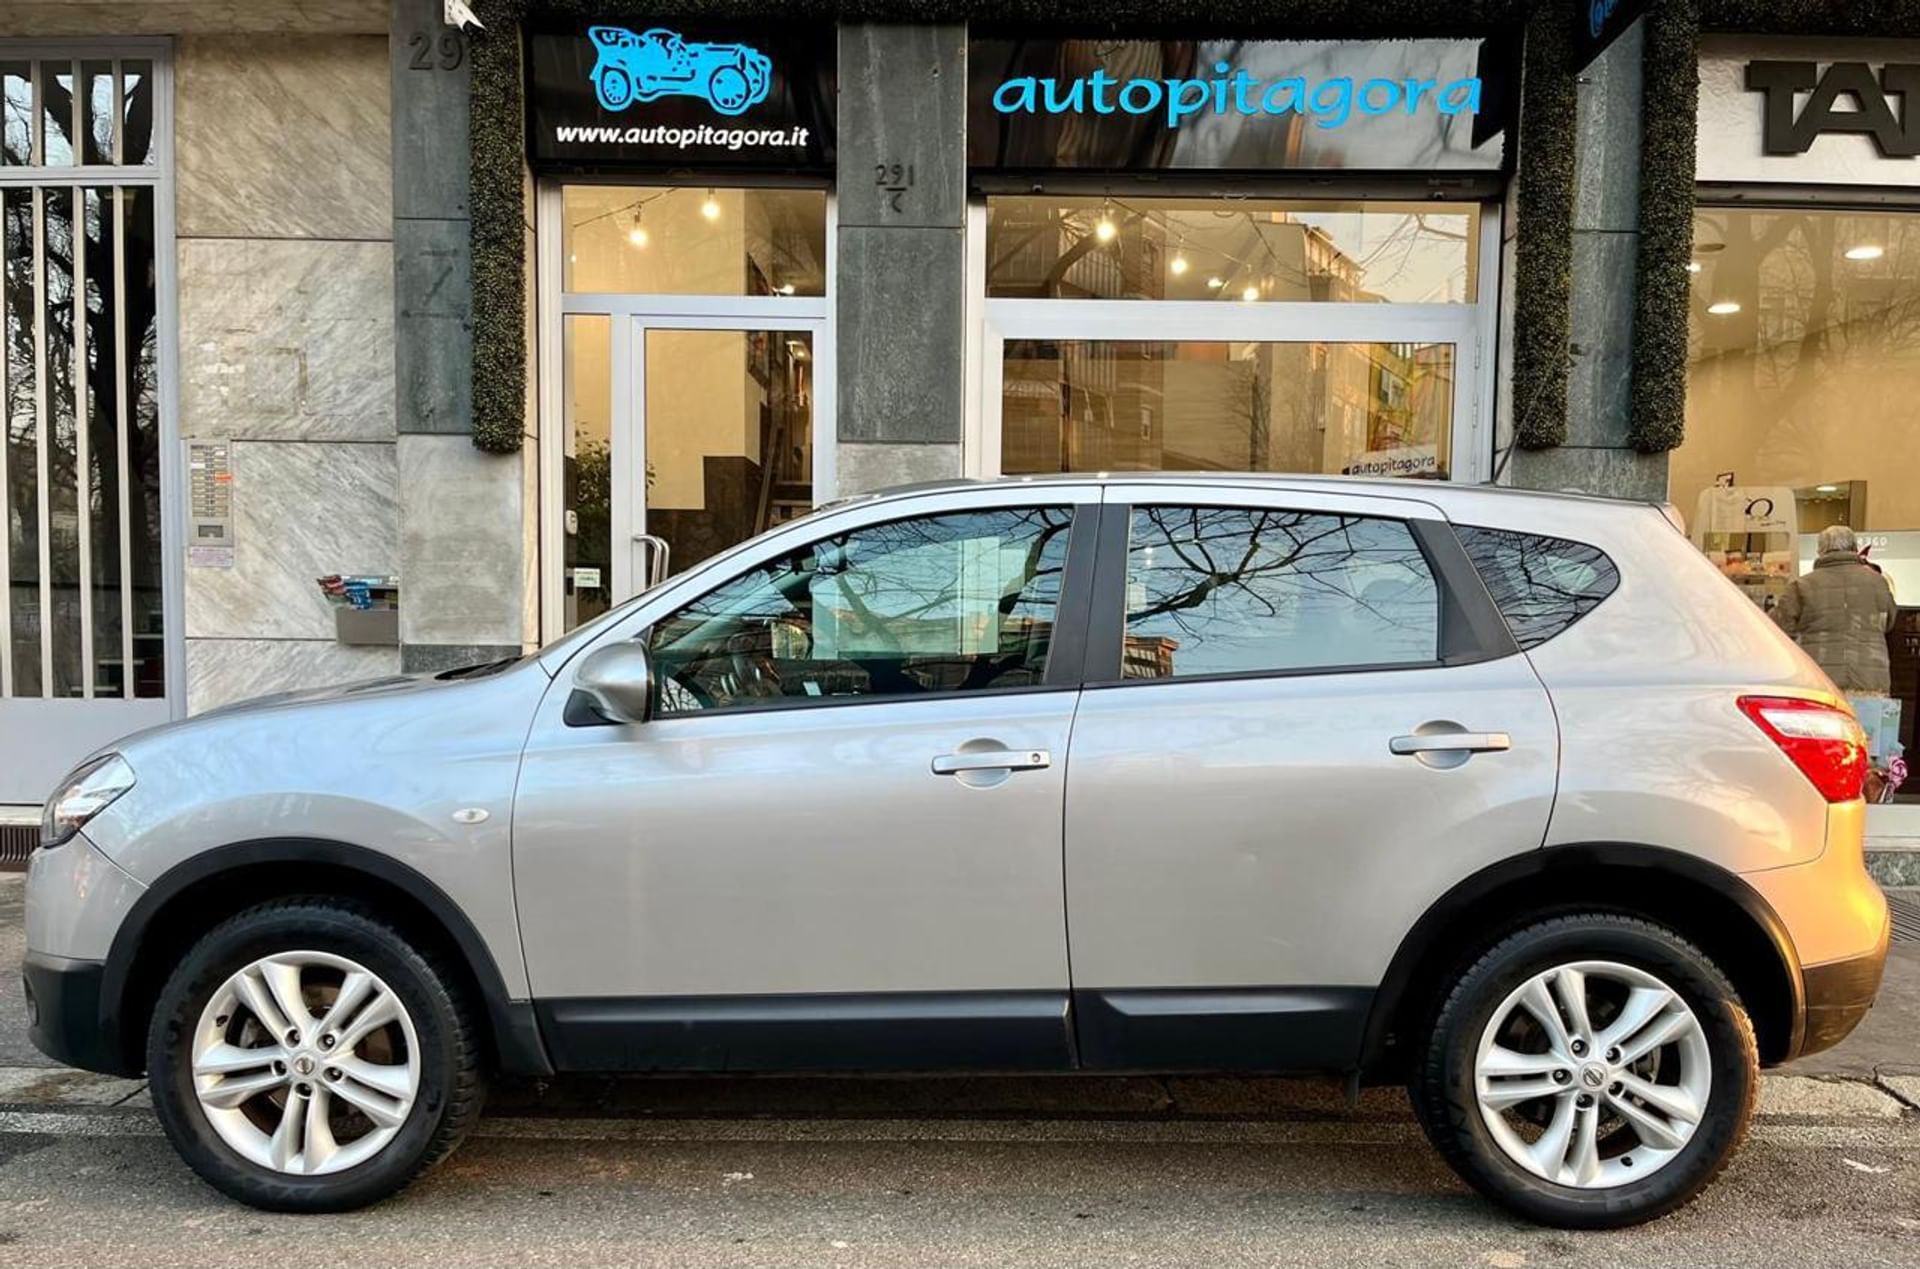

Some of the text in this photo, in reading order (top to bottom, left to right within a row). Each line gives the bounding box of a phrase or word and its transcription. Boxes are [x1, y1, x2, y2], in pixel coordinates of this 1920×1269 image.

[993, 62, 1482, 129] autopitagora
[556, 125, 809, 151] www.autopitagora.it
[874, 164, 914, 187] 291
[1351, 456, 1435, 475] autopitagora
